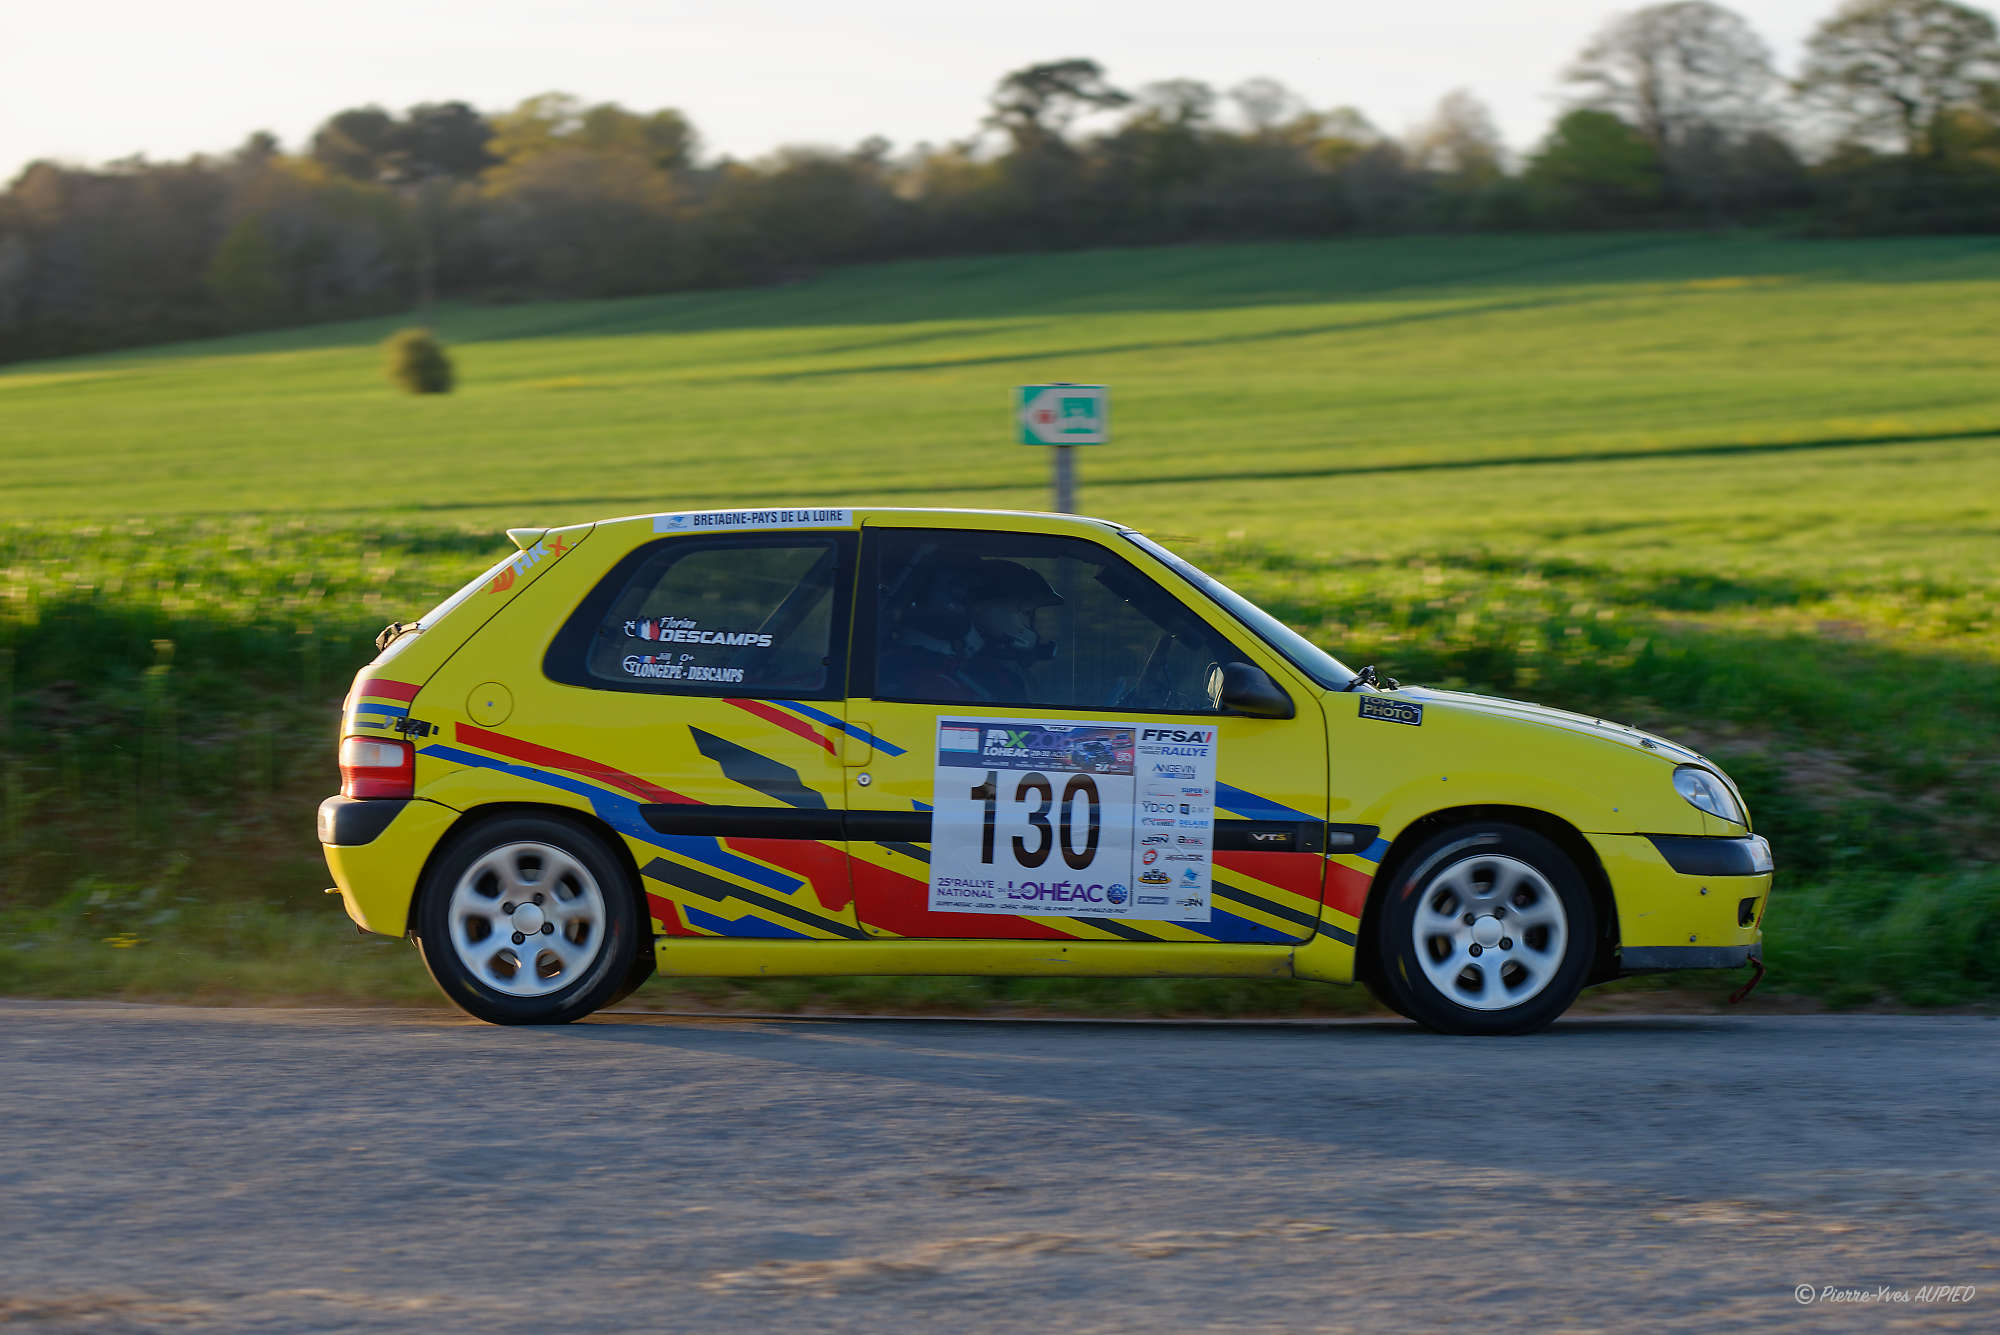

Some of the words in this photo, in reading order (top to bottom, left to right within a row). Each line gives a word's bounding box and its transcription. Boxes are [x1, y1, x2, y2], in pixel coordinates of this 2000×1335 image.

[693, 512, 777, 526] BRETAGNE-PAYS
[781, 511, 794, 522] DE
[797, 510, 810, 522] LA
[813, 510, 843, 522] LOIRE
[658, 629, 773, 647] DESCAMPS
[686, 666, 745, 683] DESCAMPS
[1363, 703, 1414, 720] PHOTO
[1141, 728, 1204, 744] FFSA
[983, 746, 1030, 758] LOHEAC
[1161, 746, 1209, 757] RALLYE
[971, 770, 1101, 871] 130
[937, 887, 995, 899] NATIONAL
[1007, 880, 1104, 903] LOHÉAC
